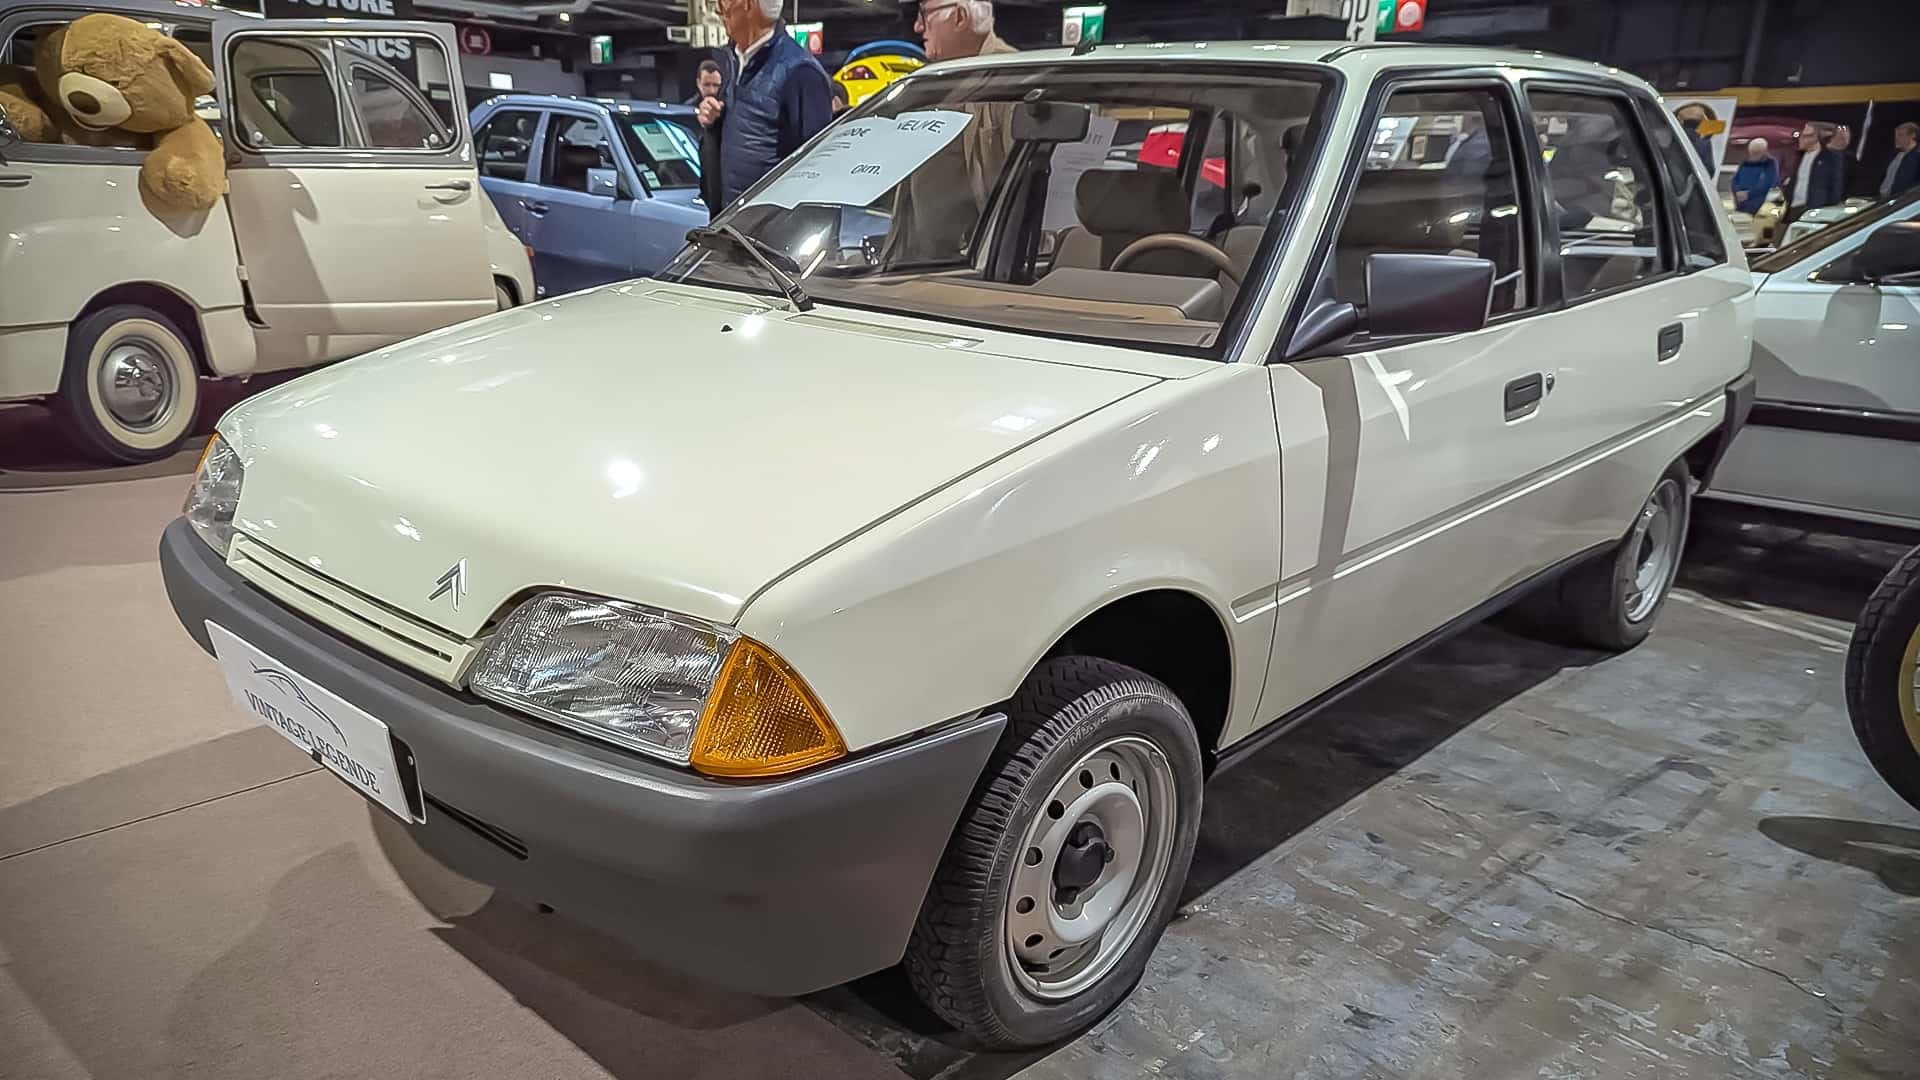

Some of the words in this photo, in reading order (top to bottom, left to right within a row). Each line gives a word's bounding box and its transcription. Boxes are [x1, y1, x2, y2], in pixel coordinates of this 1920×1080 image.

[287, 0, 395, 16] URE
[244, 688, 311, 745] VINTAGE
[308, 729, 381, 794] LEGENDE
